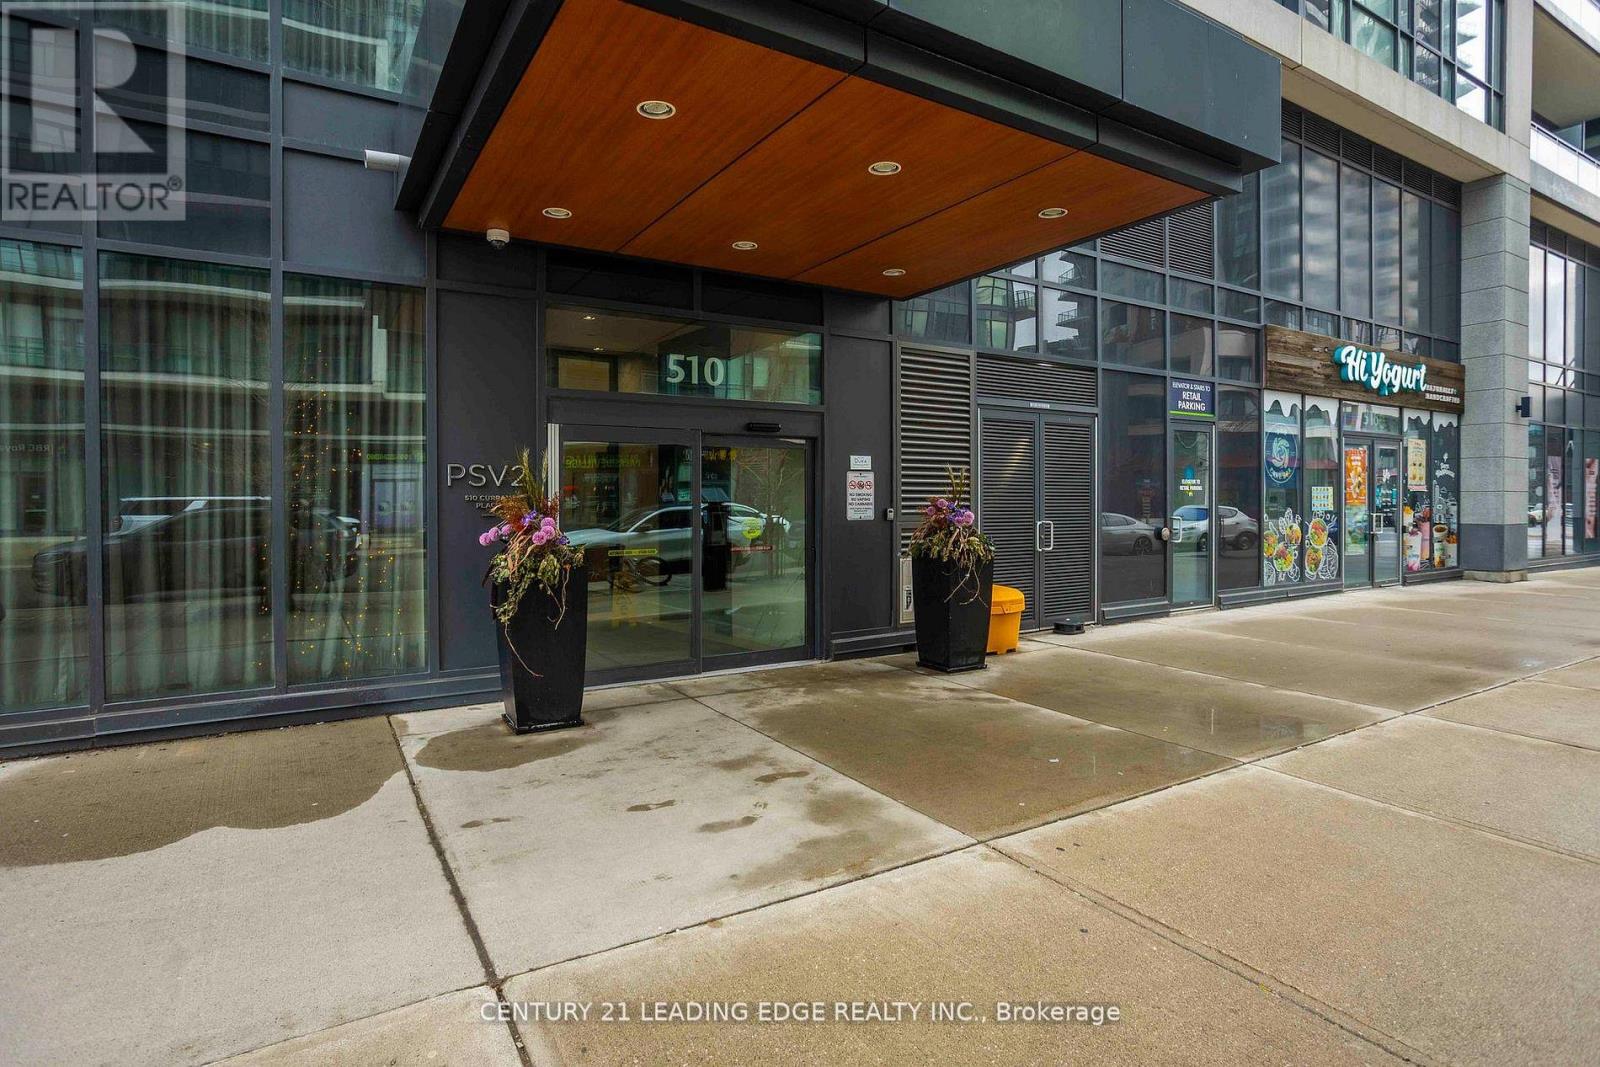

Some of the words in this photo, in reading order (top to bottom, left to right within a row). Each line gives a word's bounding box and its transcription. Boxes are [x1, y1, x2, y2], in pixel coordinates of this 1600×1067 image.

[666, 353, 725, 387] 510
[1340, 345, 1369, 383] Hi
[1370, 351, 1428, 396] Yogurt
[1178, 400, 1206, 411] PARKING
[1182, 391, 1202, 401] RETAIL
[447, 463, 526, 487] PSV2
